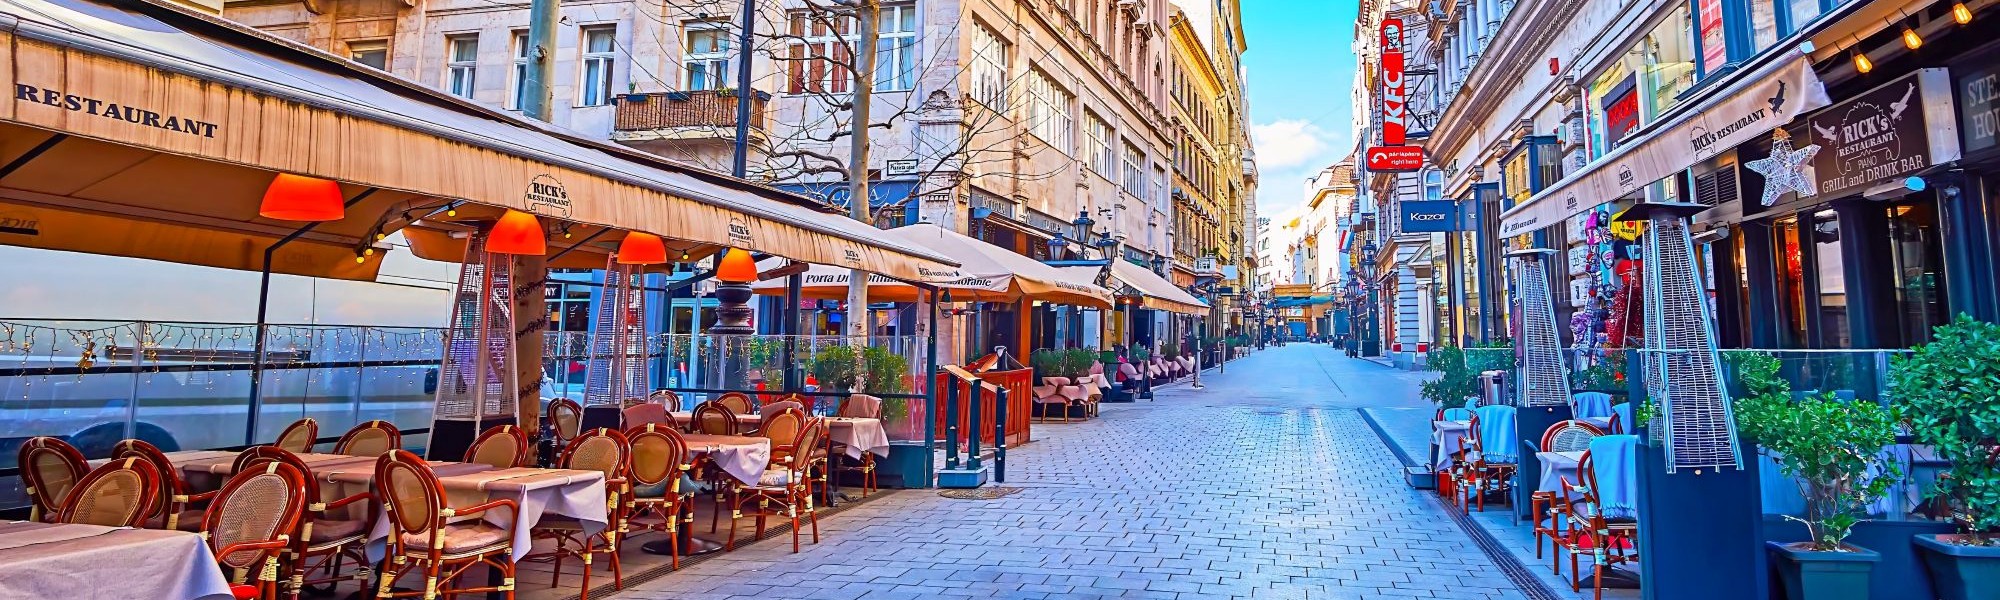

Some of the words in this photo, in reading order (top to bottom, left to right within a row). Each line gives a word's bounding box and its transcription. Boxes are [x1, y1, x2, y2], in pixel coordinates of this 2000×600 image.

[1383, 69, 1404, 127] KFC
[1967, 73, 2000, 108] STE
[15, 83, 218, 139] RESTAURANT
[1692, 131, 1717, 152] RICK's
[1716, 108, 1766, 140] RESTAURANT
[1843, 114, 1888, 144] RICK's
[1839, 131, 1894, 157] RESTAURANT
[1822, 175, 1848, 194] GRILL
[1848, 170, 1865, 187] and
[1866, 160, 1900, 182] DRINK
[1900, 154, 1925, 173] BAR
[1857, 155, 1877, 170] PIANO
[527, 193, 571, 207] RESTAURANT
[533, 182, 568, 200] RICK's
[1410, 212, 1446, 221] Kazar
[805, 274, 834, 284] Porta
